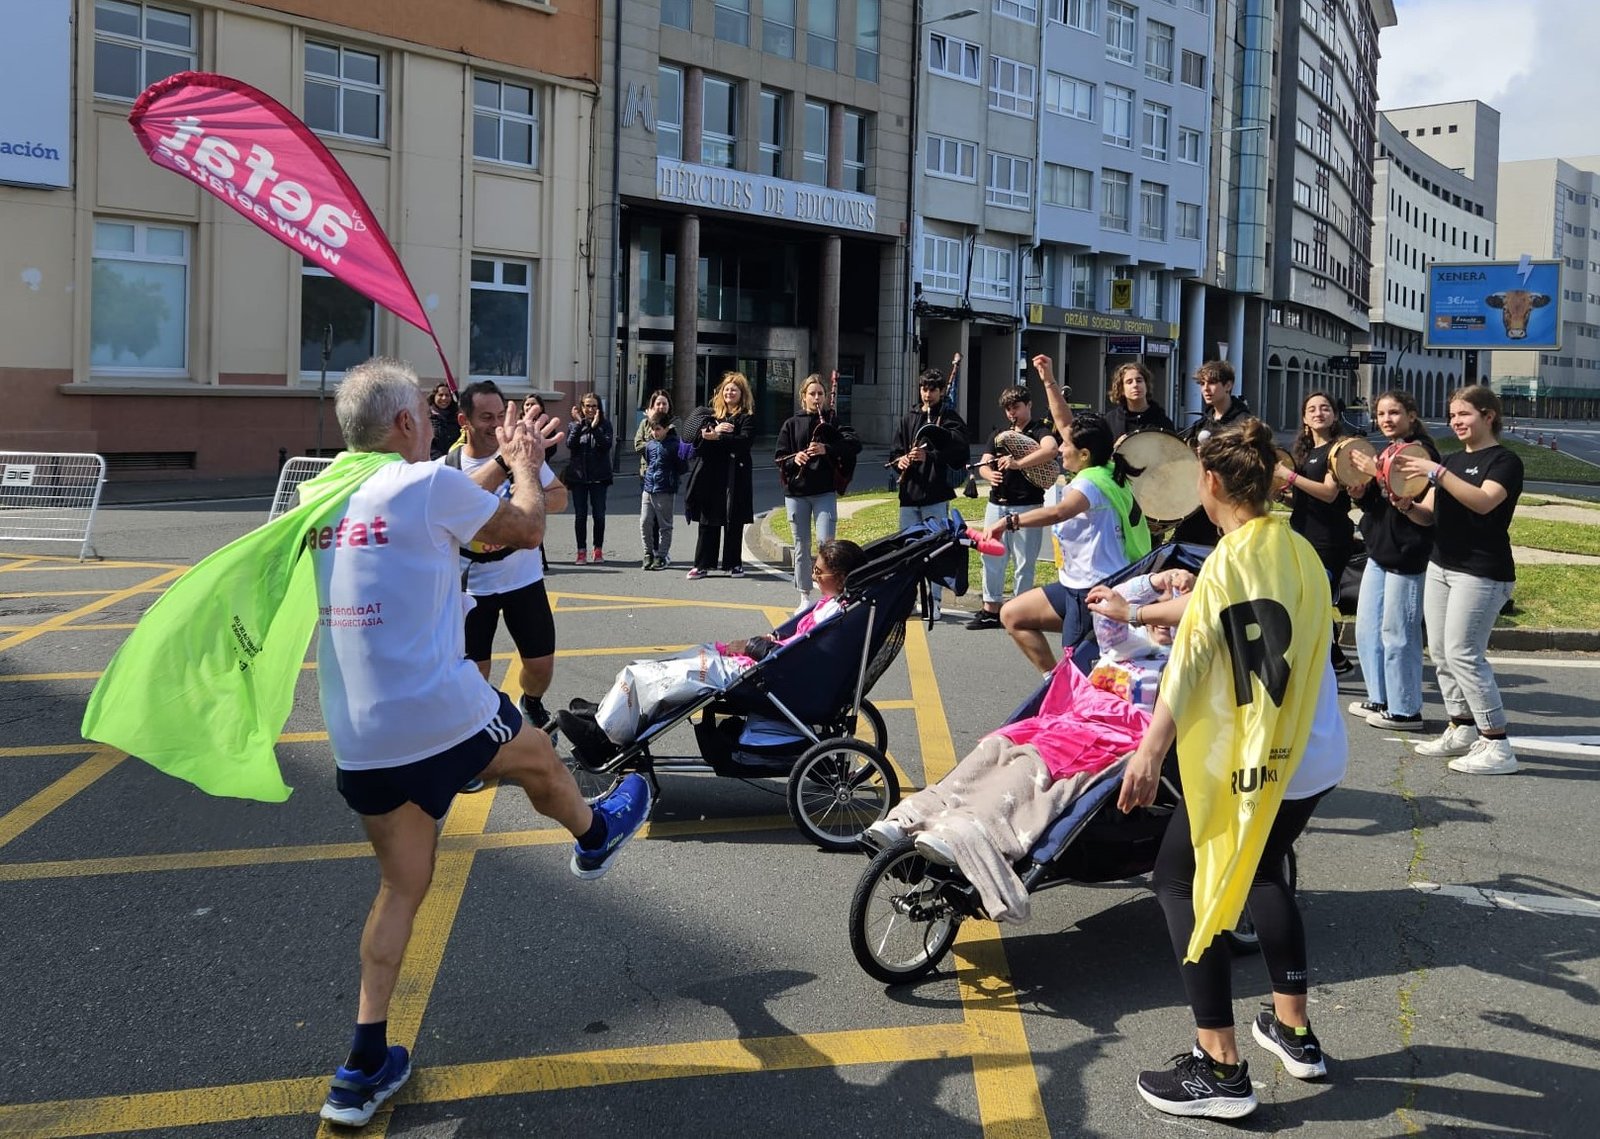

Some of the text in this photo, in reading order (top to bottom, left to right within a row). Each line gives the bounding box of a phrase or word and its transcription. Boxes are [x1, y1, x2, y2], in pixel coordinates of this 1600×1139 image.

[0, 141, 60, 160] ación
[660, 163, 876, 230] HÉRCULES DE EDICIONES
[1437, 271, 1487, 281] XENERA
[1064, 312, 1154, 334] ORZÁN SOCIEDAD DEPORTIVA
[308, 516, 389, 550] aefat
[1219, 598, 1293, 709] R
